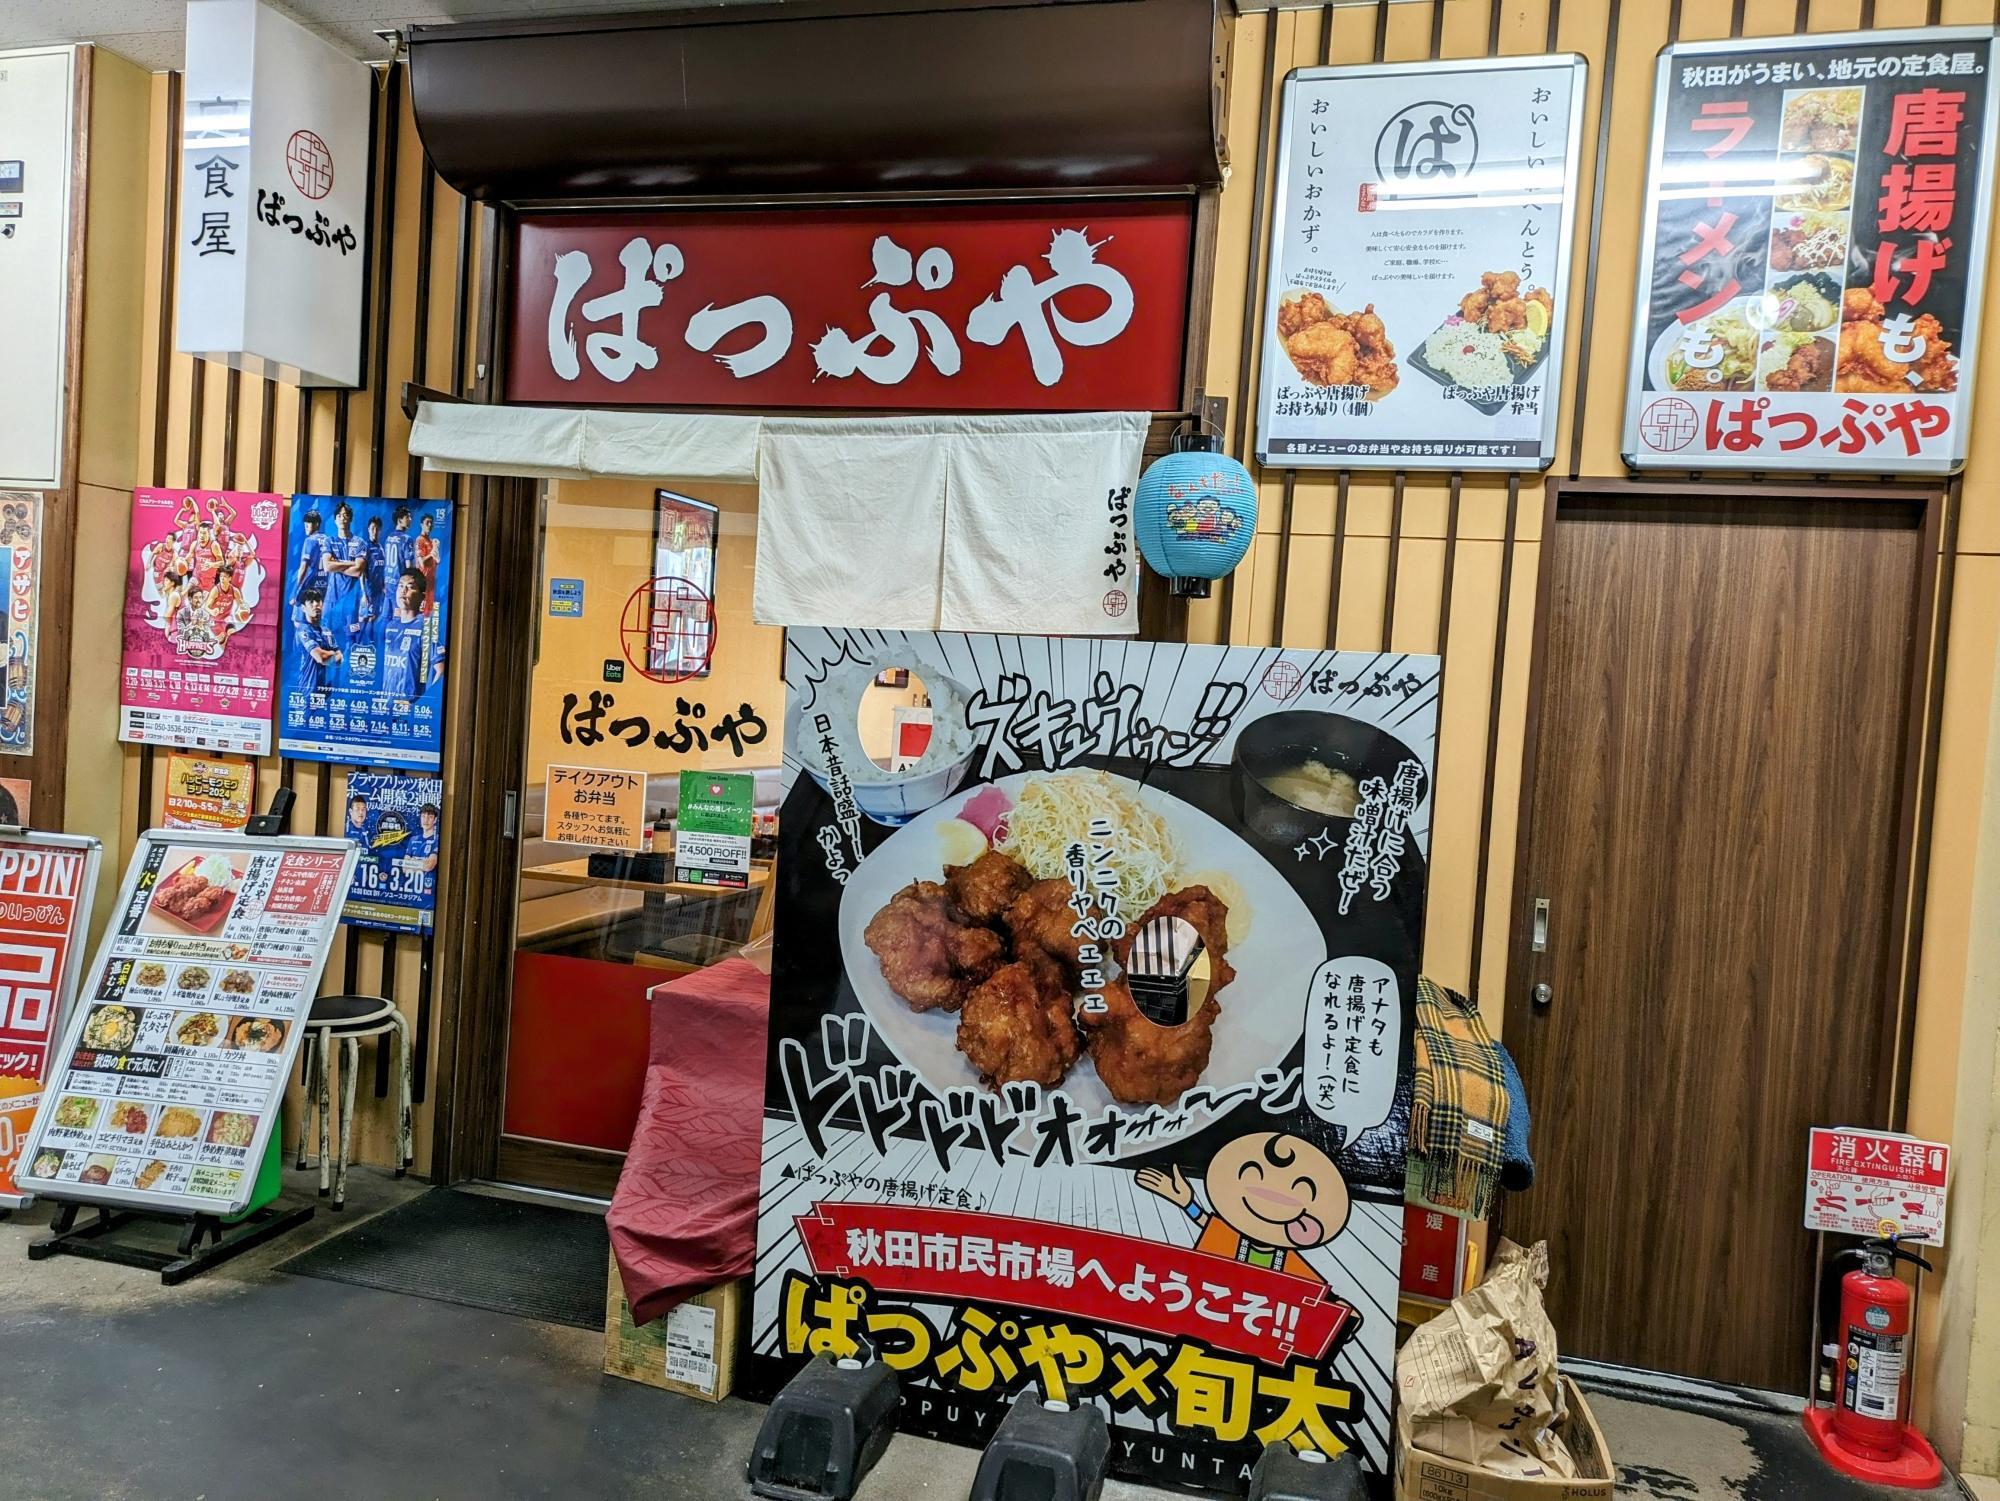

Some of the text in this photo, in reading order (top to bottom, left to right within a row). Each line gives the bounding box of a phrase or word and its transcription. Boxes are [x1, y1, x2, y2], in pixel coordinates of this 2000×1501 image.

[1682, 53, 1985, 88] 秋田がうまい、地元の定食屋。
[1301, 98, 1330, 253] おいしいおかず。
[1520, 87, 1552, 291] おいしいんとう。
[1871, 87, 1966, 386] 唐揚げも、
[1277, 385, 1369, 400] ぱっぷや唐揚げ
[1443, 385, 1541, 400] ぱっぷや唐揚げ
[1511, 402, 1538, 416] 弁当
[1286, 443, 1516, 455] 各種メニューのお弁当やお持ち帰りが可能です!
[13, 548, 32, 621] アサヒ
[347, 772, 442, 793] ブラウブリッツ秋田
[554, 770, 638, 790] テイクアウト
[574, 789, 616, 806] お弁当
[563, 811, 625, 825] 各種やってます。
[557, 821, 631, 836] スタッフへお気軽に
[1371, 759, 1422, 901] 唐揚げに合う
[558, 833, 629, 847] お申し付け下さい!
[284, 855, 342, 868] 定食シリーズ
[232, 855, 266, 919] 唐揚げ定食
[390, 867, 425, 894] 3.20
[1088, 819, 1126, 939] ニンニクの
[142, 1021, 168, 1032] スタミナ
[1368, 977, 1391, 1057] アナタも
[1342, 973, 1367, 1094] 唐揚げ定食に
[94, 1053, 166, 1074] 秋田の食で元気に!
[223, 1052, 247, 1061] カツ丼
[1831, 1135, 1926, 1168] 消火器
[1811, 1171, 1853, 1181] OPERATION
[1831, 1158, 1925, 1176] FIRE EXTINGUISHER
[845, 1228, 1300, 1342] 秋田市民市場へようこそ!!
[1427, 1464, 1463, 1484] 86113
[1572, 1488, 1607, 1497] HOLUS
